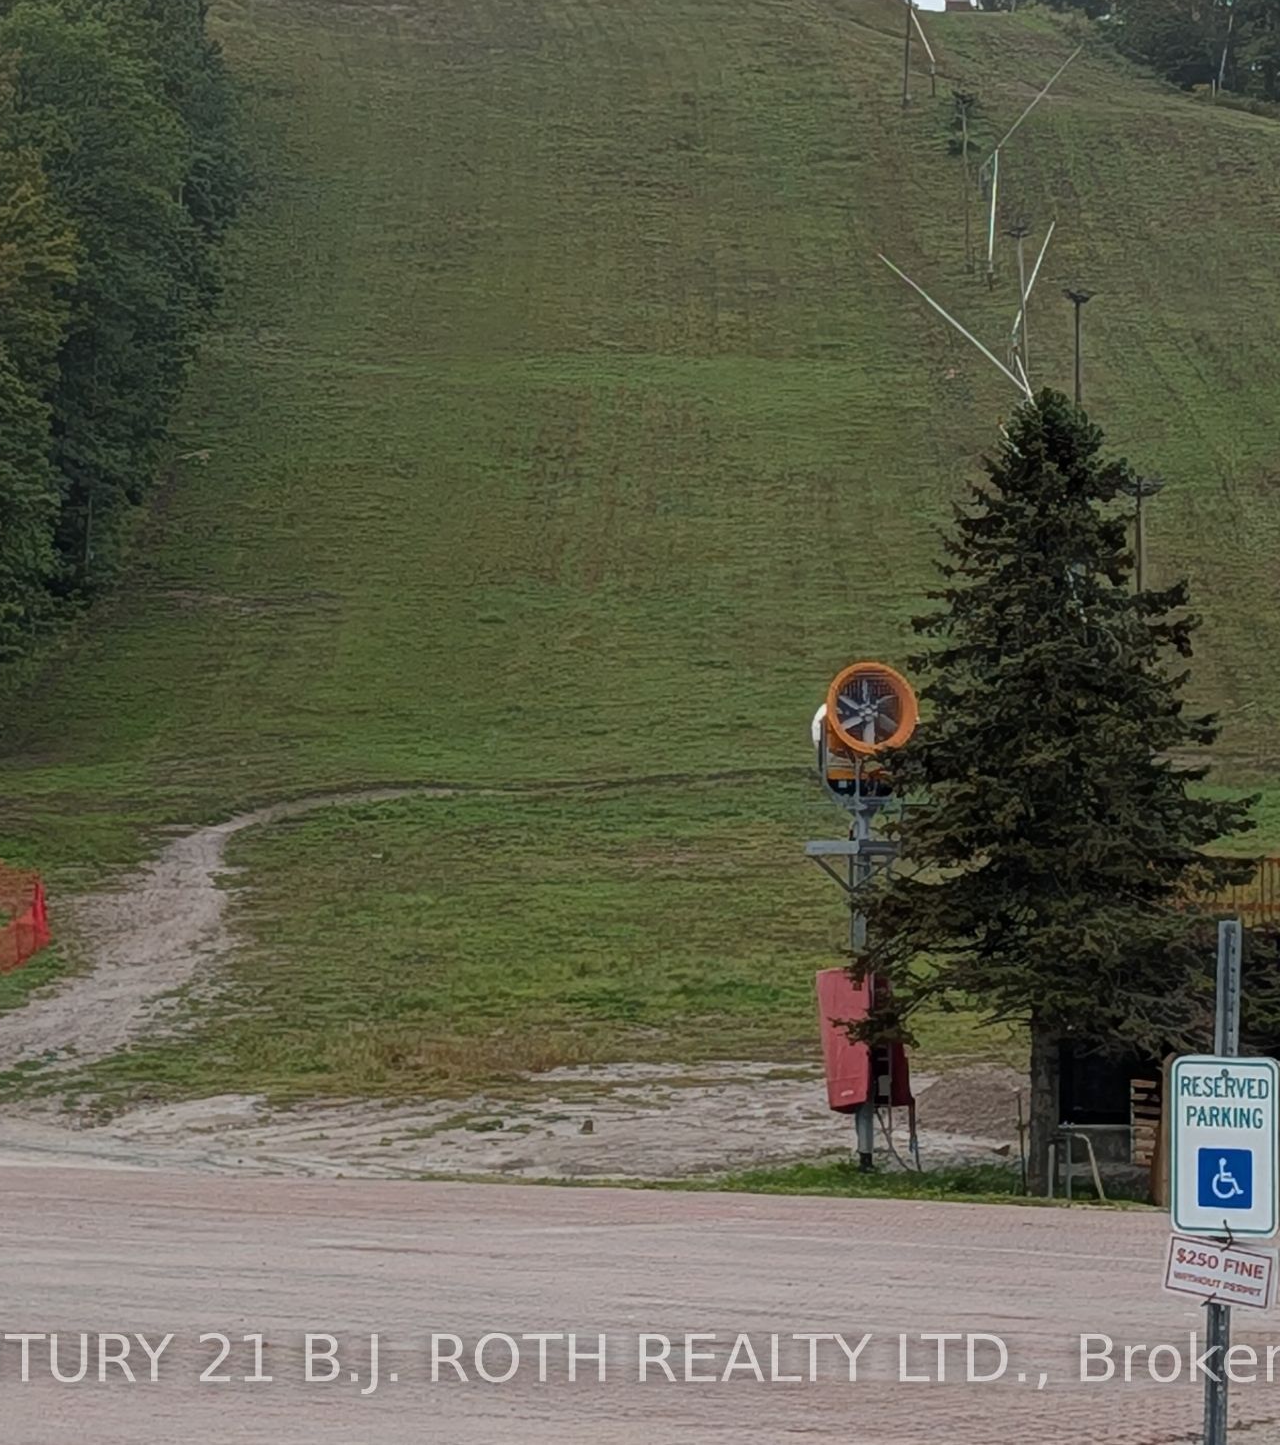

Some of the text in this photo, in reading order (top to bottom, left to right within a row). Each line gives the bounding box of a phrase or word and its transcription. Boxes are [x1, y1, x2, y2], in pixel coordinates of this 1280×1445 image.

[1180, 1075, 1269, 1099] RESERVED
[1186, 1105, 1263, 1129] PARKING
[1176, 1247, 1265, 1280] $250 FINE
